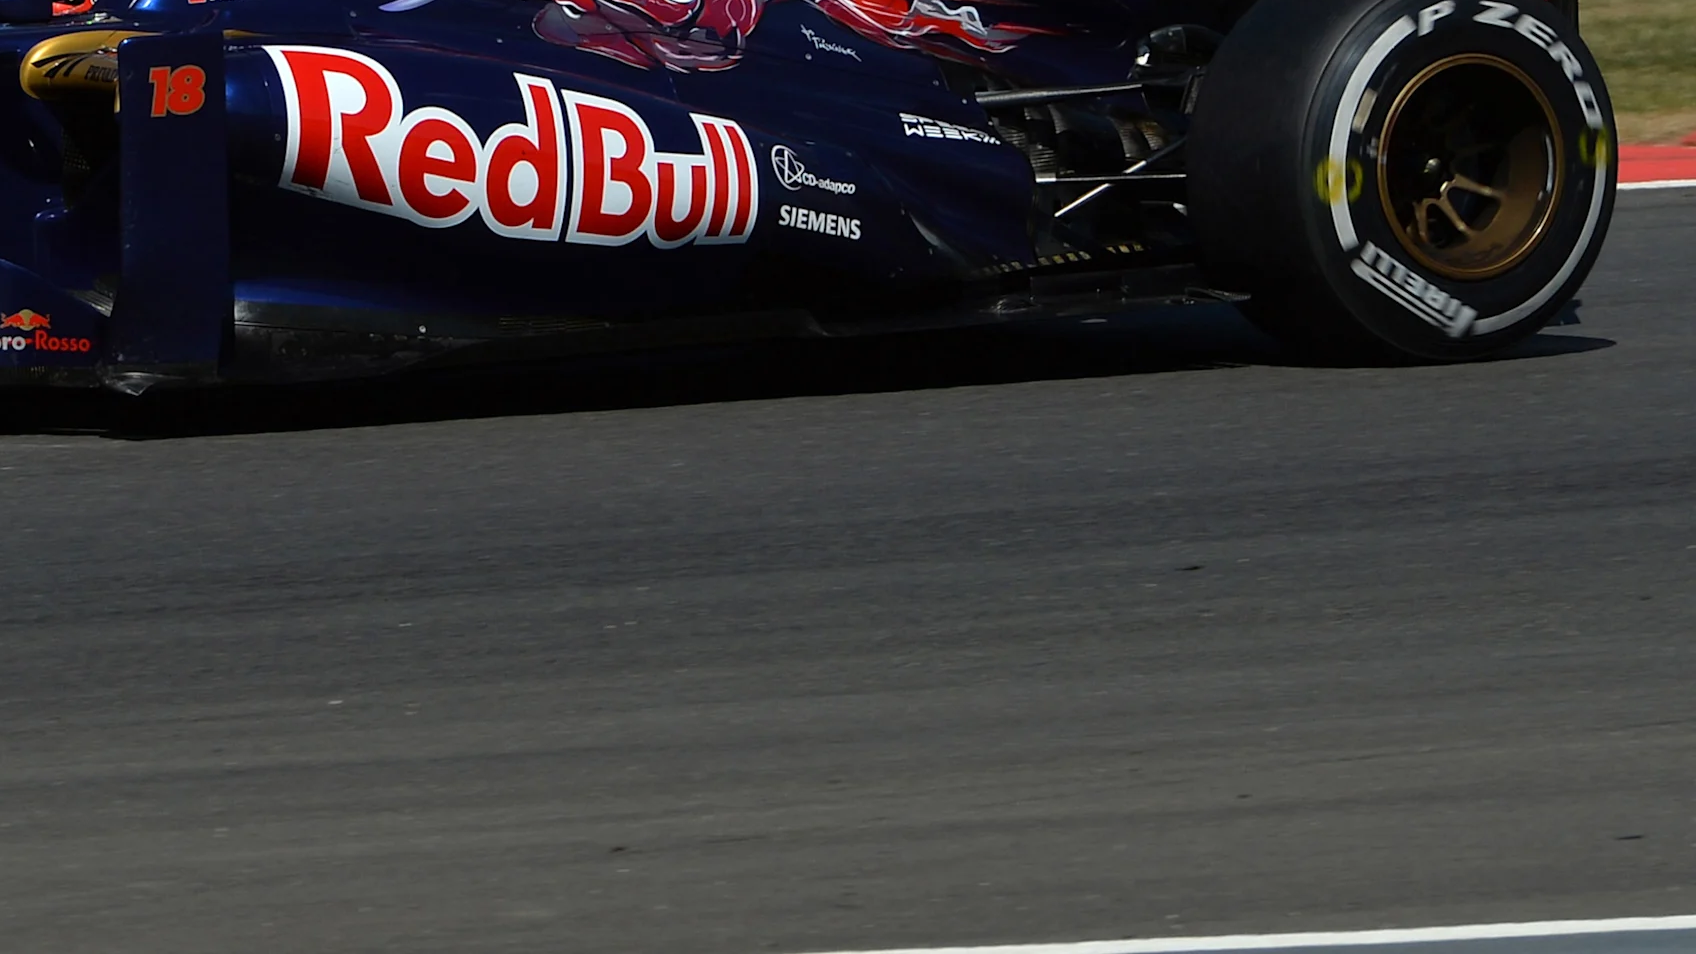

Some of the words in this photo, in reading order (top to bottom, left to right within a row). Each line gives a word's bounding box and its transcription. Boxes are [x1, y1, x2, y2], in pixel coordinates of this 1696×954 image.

[149, 64, 206, 117] 18
[1473, 0, 1603, 129] ZERO
[778, 205, 861, 240] SIEMENS
[1350, 242, 1478, 338] PIRELLI
[35, 330, 91, 352] Rosso
